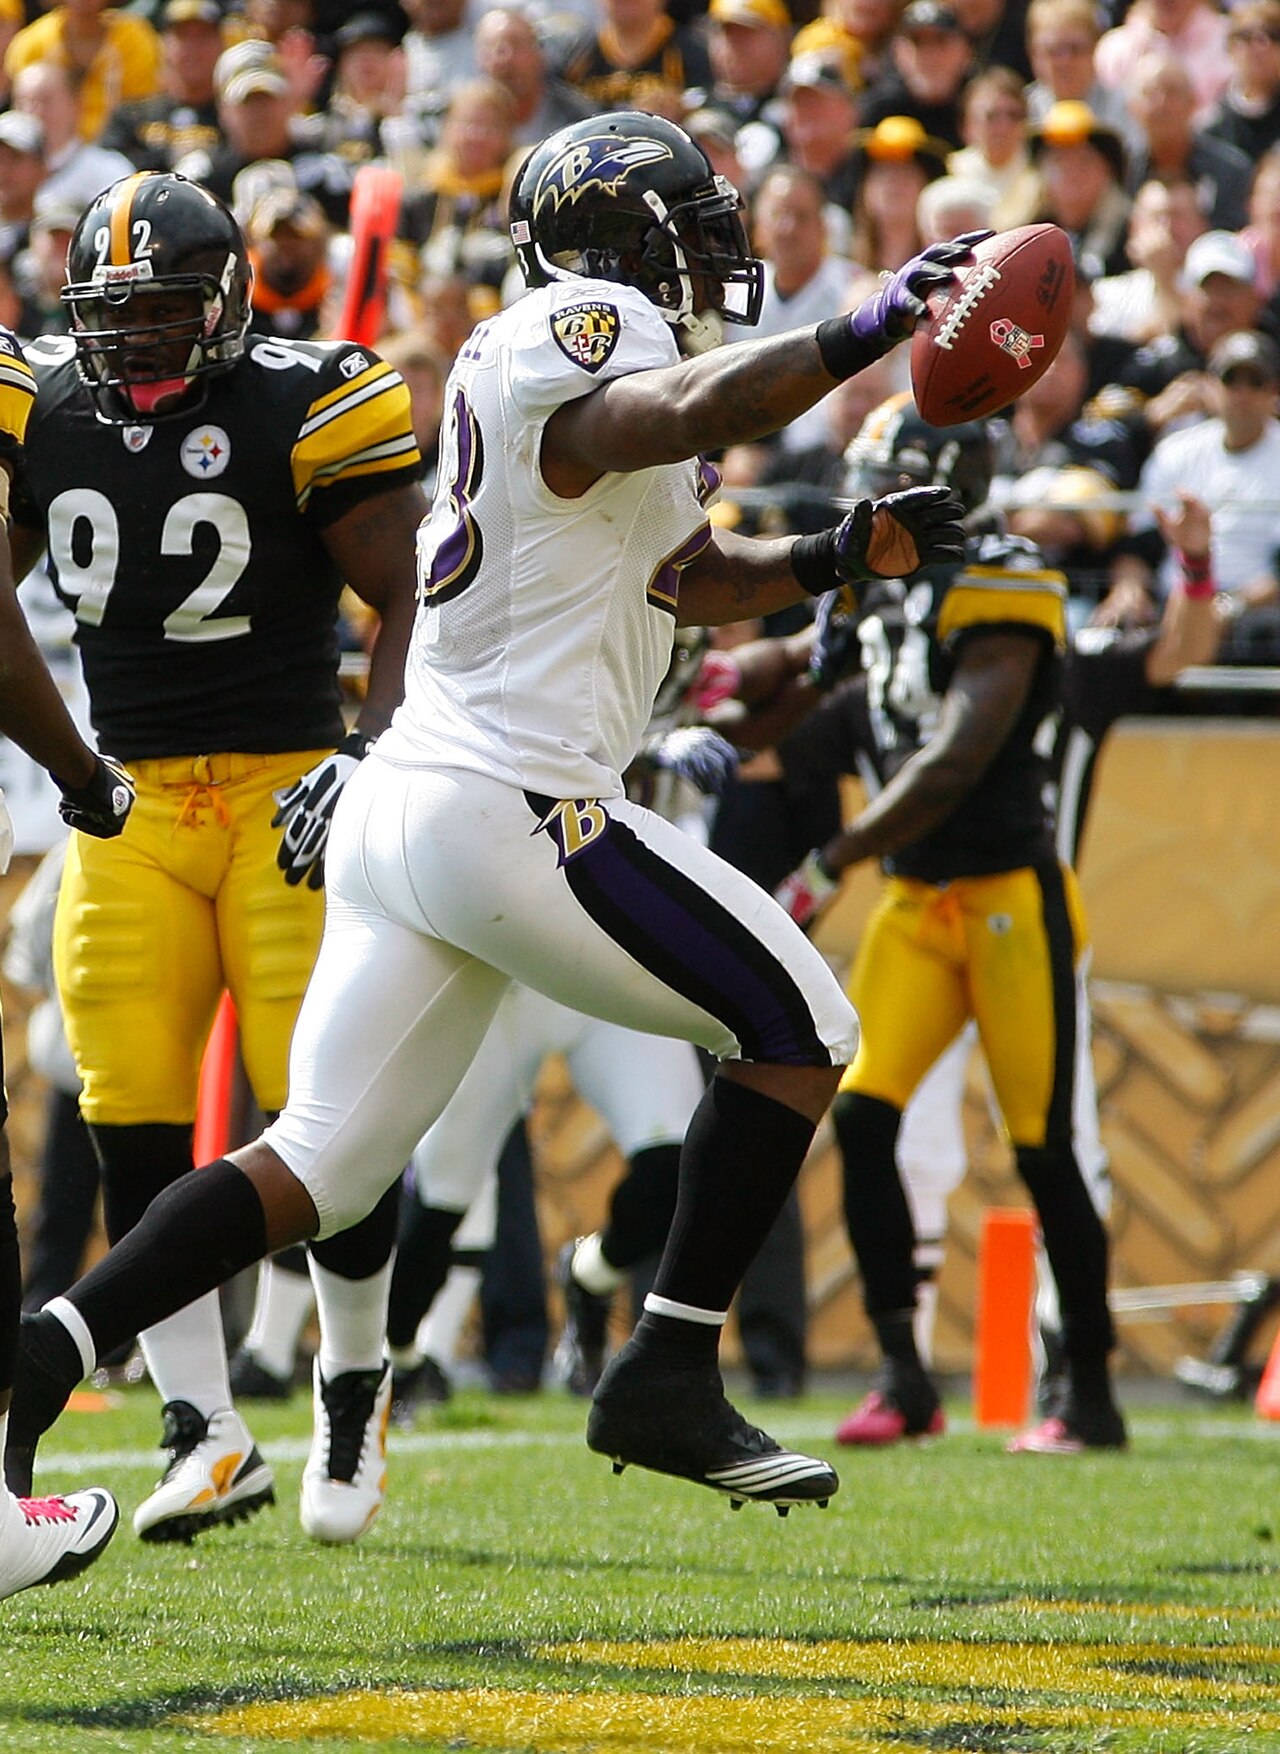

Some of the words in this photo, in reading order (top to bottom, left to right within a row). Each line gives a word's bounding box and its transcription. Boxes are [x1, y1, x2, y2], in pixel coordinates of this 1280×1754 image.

[94, 219, 154, 265] 92
[553, 303, 612, 321] RAVENS
[48, 487, 253, 643] 92
